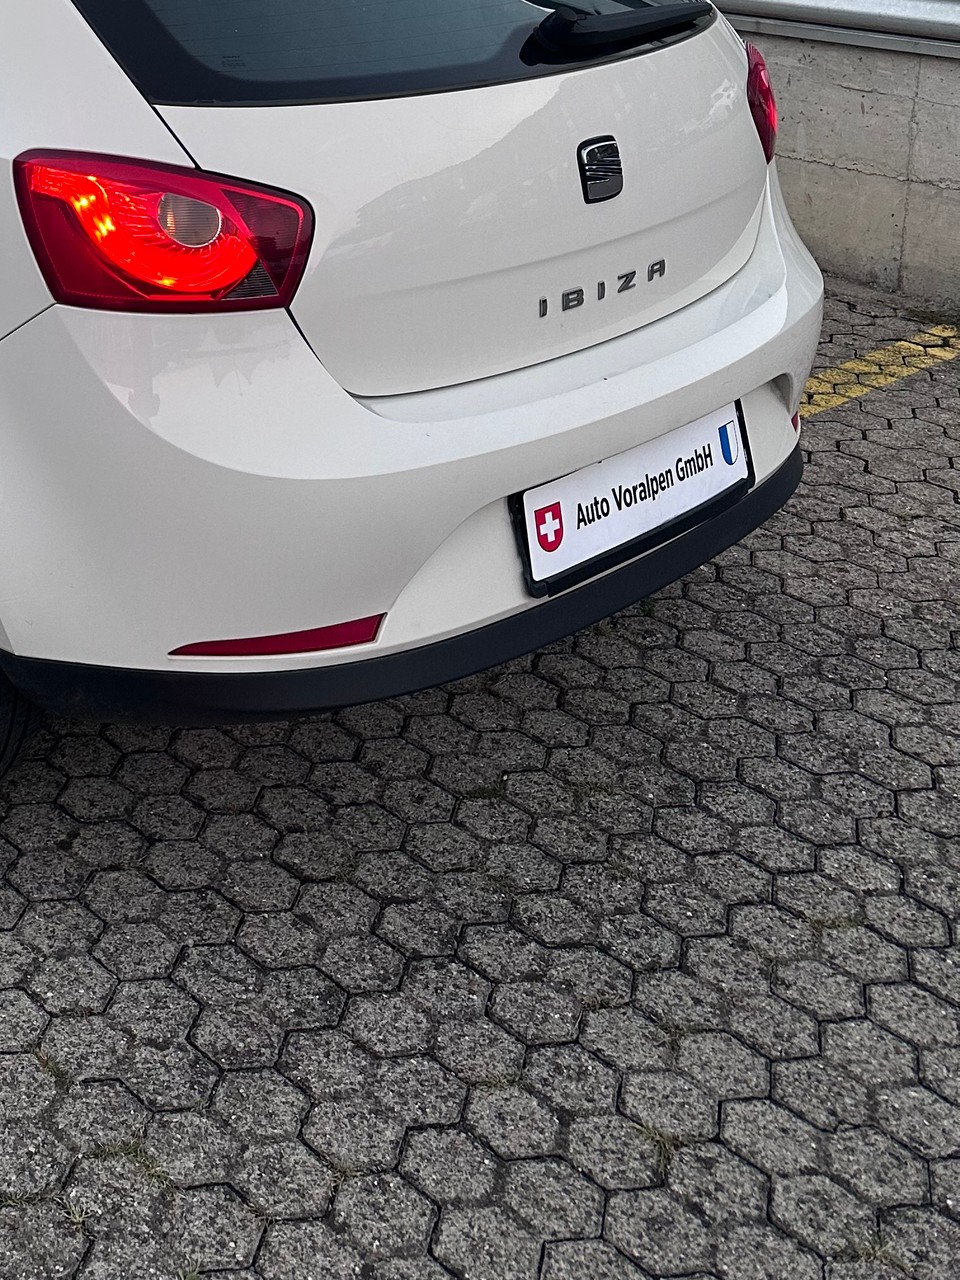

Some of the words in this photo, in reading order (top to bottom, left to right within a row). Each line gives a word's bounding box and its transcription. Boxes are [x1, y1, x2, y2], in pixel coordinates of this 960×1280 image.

[539, 258, 666, 318] IBIZA
[576, 496, 610, 530] Auto
[611, 468, 674, 511] Voralpen
[675, 443, 714, 482] GmbH
